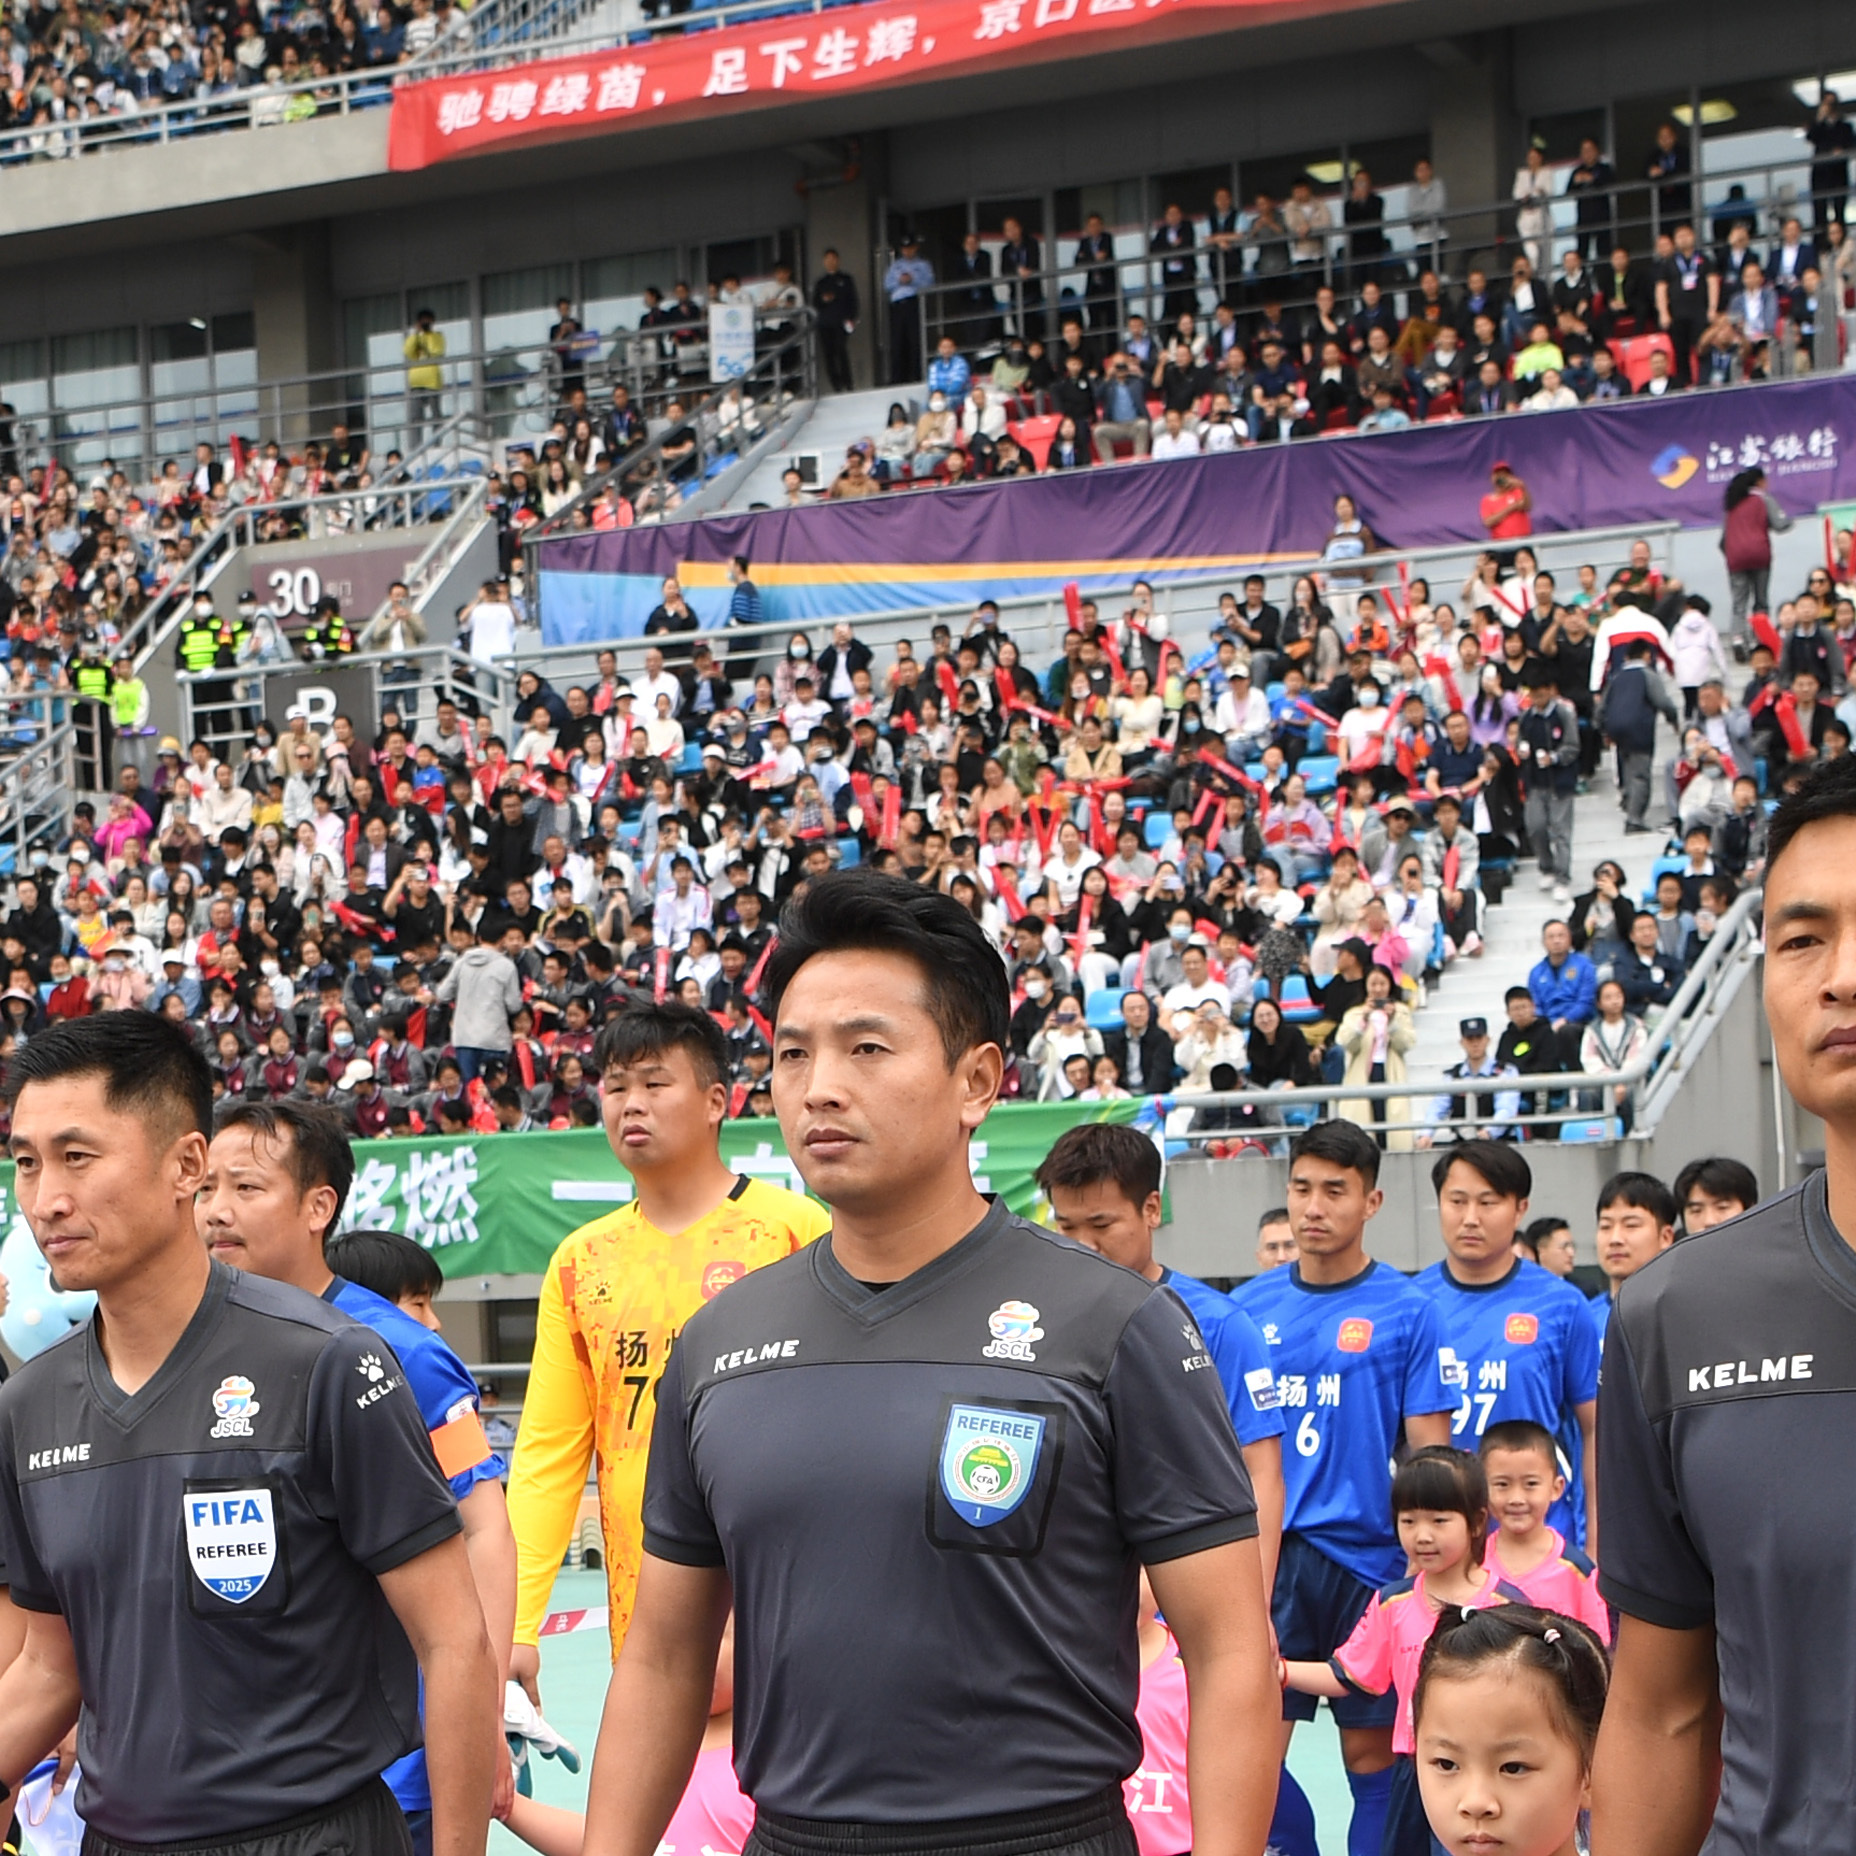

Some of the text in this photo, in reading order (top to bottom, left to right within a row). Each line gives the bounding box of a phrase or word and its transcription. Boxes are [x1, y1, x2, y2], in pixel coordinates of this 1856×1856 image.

[268, 566, 320, 618] 30
[713, 1340, 800, 1374] KELME
[982, 1340, 1037, 1362] JSCL
[1688, 1354, 1815, 1393] KELME
[1276, 1374, 1341, 1408] 扬州
[210, 1417, 254, 1439] JSCL
[956, 1415, 1035, 1442] REFEREE
[1295, 1411, 1320, 1457] 6
[29, 1443, 91, 1471] KELME
[192, 1497, 265, 1528] FIFA
[196, 1542, 267, 1560] REFEREE
[219, 1578, 253, 1594] 2025
